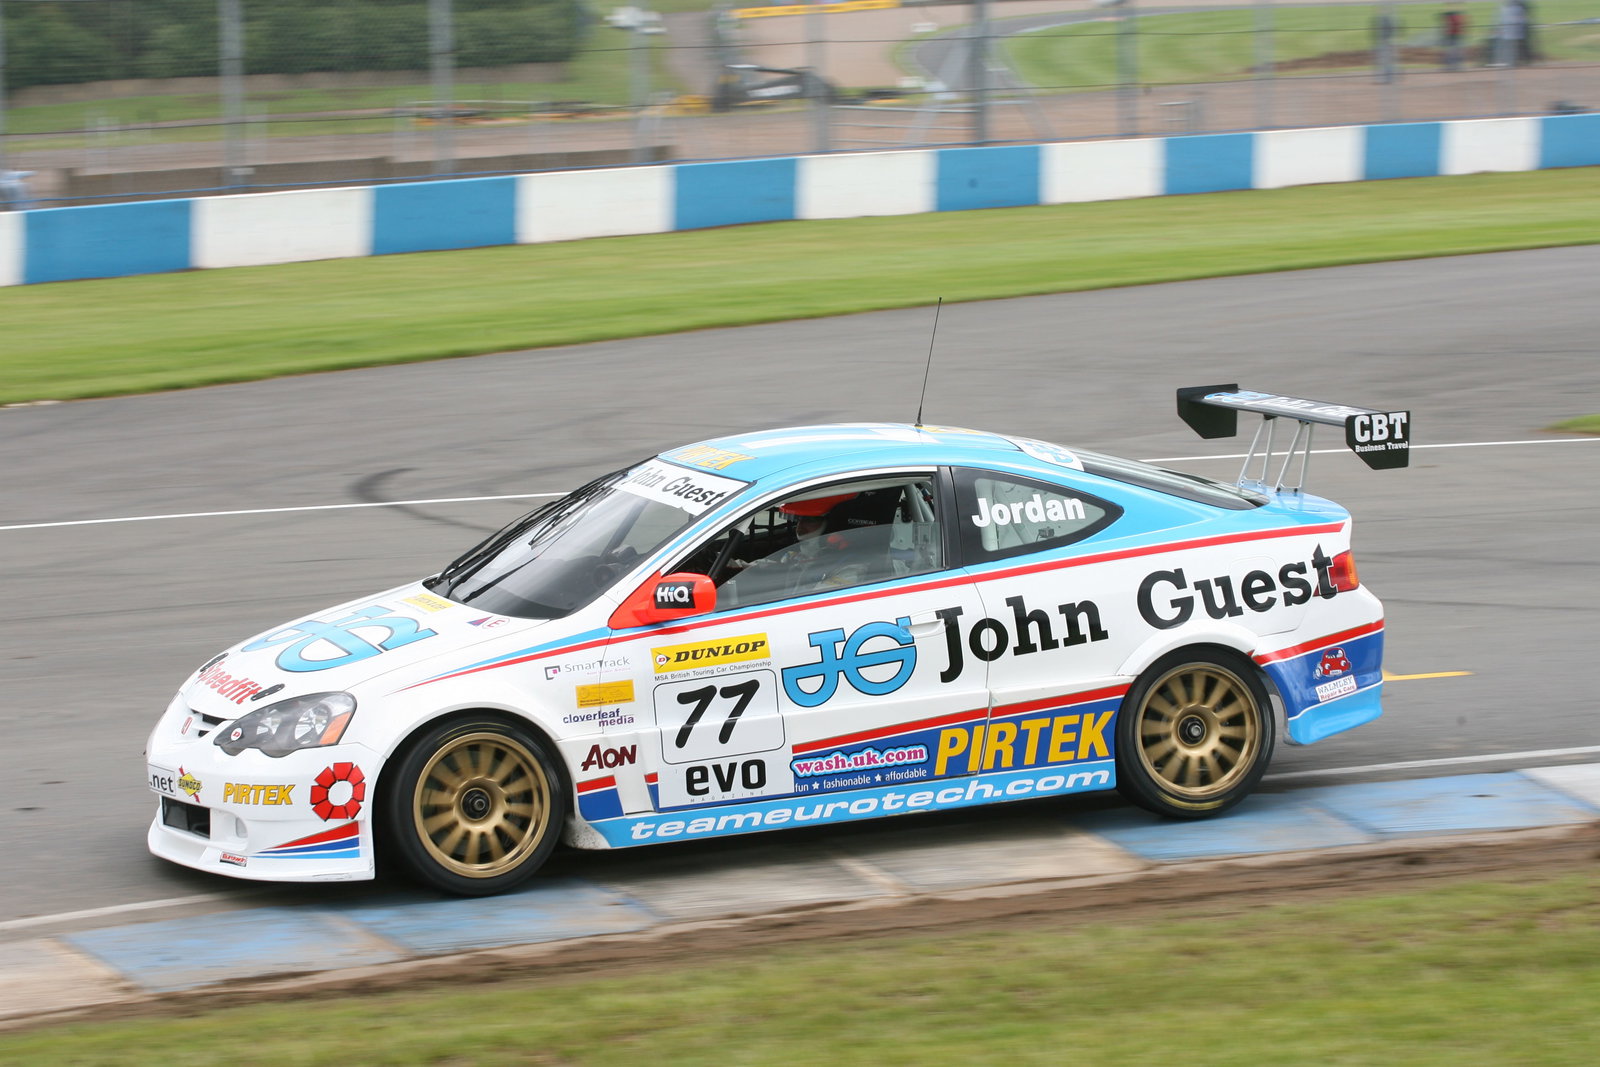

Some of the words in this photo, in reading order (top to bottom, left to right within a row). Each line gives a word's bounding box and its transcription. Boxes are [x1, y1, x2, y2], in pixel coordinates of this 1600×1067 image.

[1354, 412, 1407, 443] CBT
[1355, 444, 1385, 453] Business
[1387, 441, 1408, 451] Travel
[662, 476, 726, 506] Guest
[971, 493, 1086, 528] Jordan
[656, 586, 690, 603] HiQ
[935, 595, 1109, 684] John
[1137, 543, 1338, 631] Guest
[674, 640, 766, 663] DUNLOP
[671, 672, 691, 680] British
[693, 668, 715, 677] Touring
[729, 660, 772, 672] Championship
[563, 708, 620, 724] cloverleaf
[598, 715, 635, 727] media
[675, 679, 760, 749] 77
[934, 710, 1116, 776] PIRTEK
[795, 748, 925, 773] wash.uk.com
[178, 778, 201, 792] SUNOCO
[686, 759, 767, 796] evo
[795, 782, 809, 793] fun
[823, 774, 871, 789] fashionable
[885, 768, 927, 781] affordable
[223, 782, 296, 805] PIRTEK
[630, 768, 1111, 841] teameurotech.com
